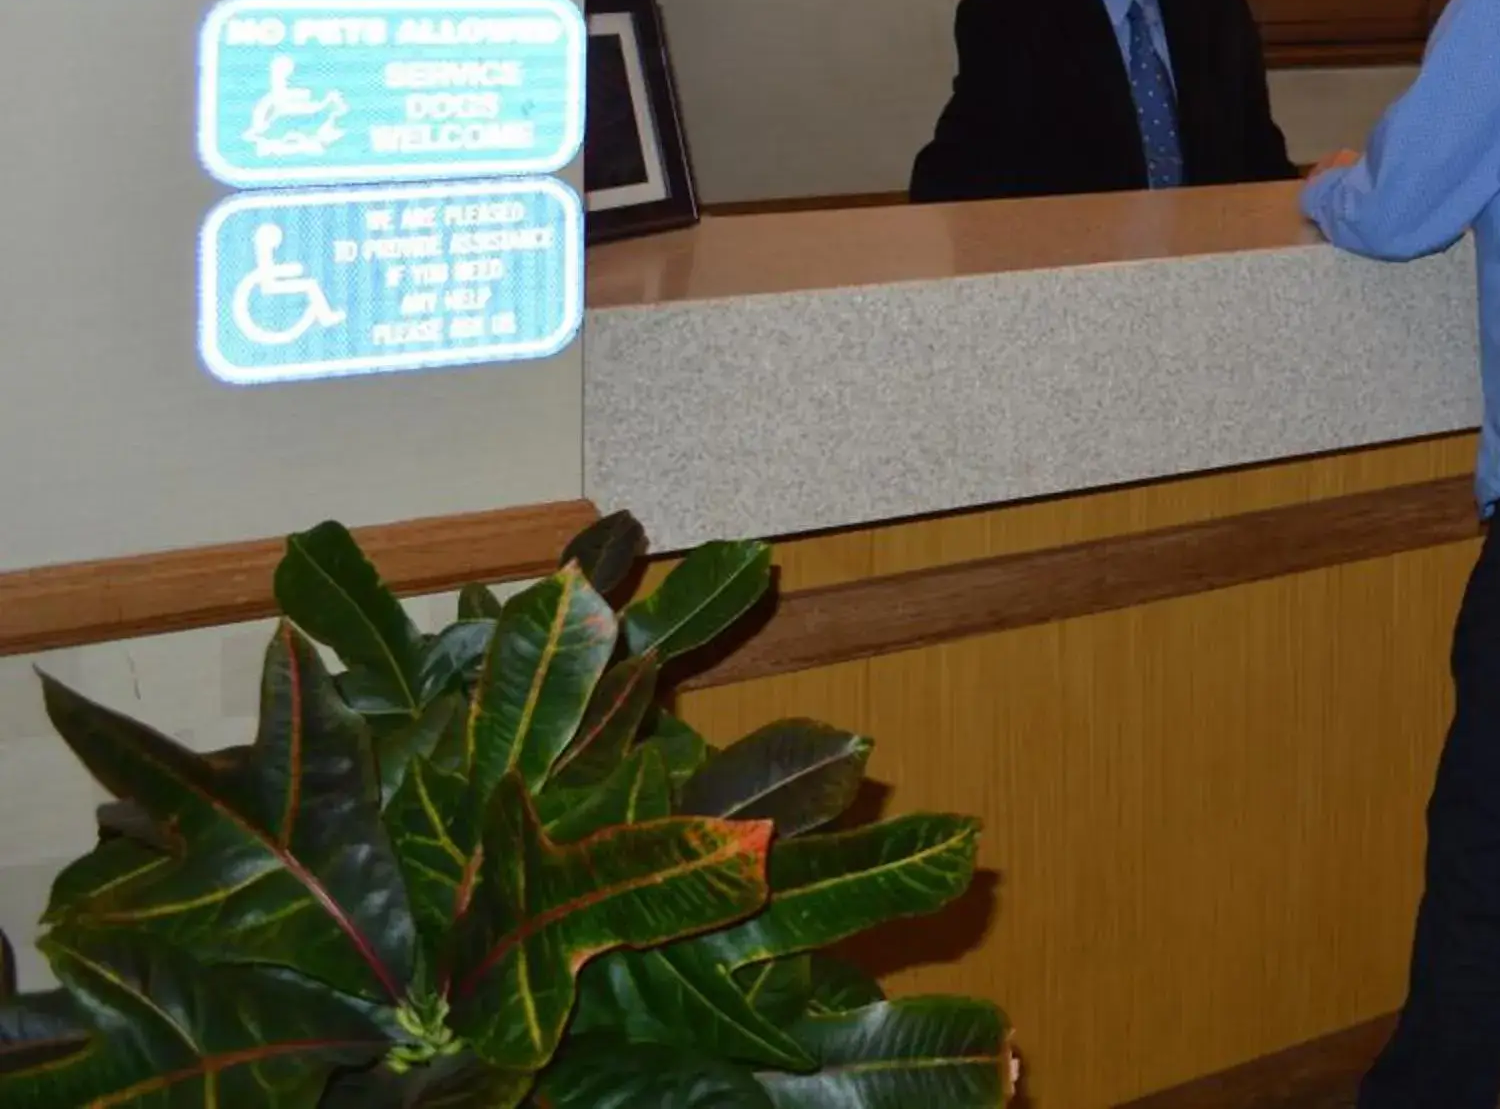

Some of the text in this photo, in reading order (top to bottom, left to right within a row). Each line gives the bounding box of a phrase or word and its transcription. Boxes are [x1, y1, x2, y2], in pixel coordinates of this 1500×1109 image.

[227, 18, 285, 46] NO
[293, 18, 387, 45] PETS
[386, 61, 520, 87] SERVICE
[406, 93, 498, 118] DOGS
[371, 122, 536, 152] WELCOME
